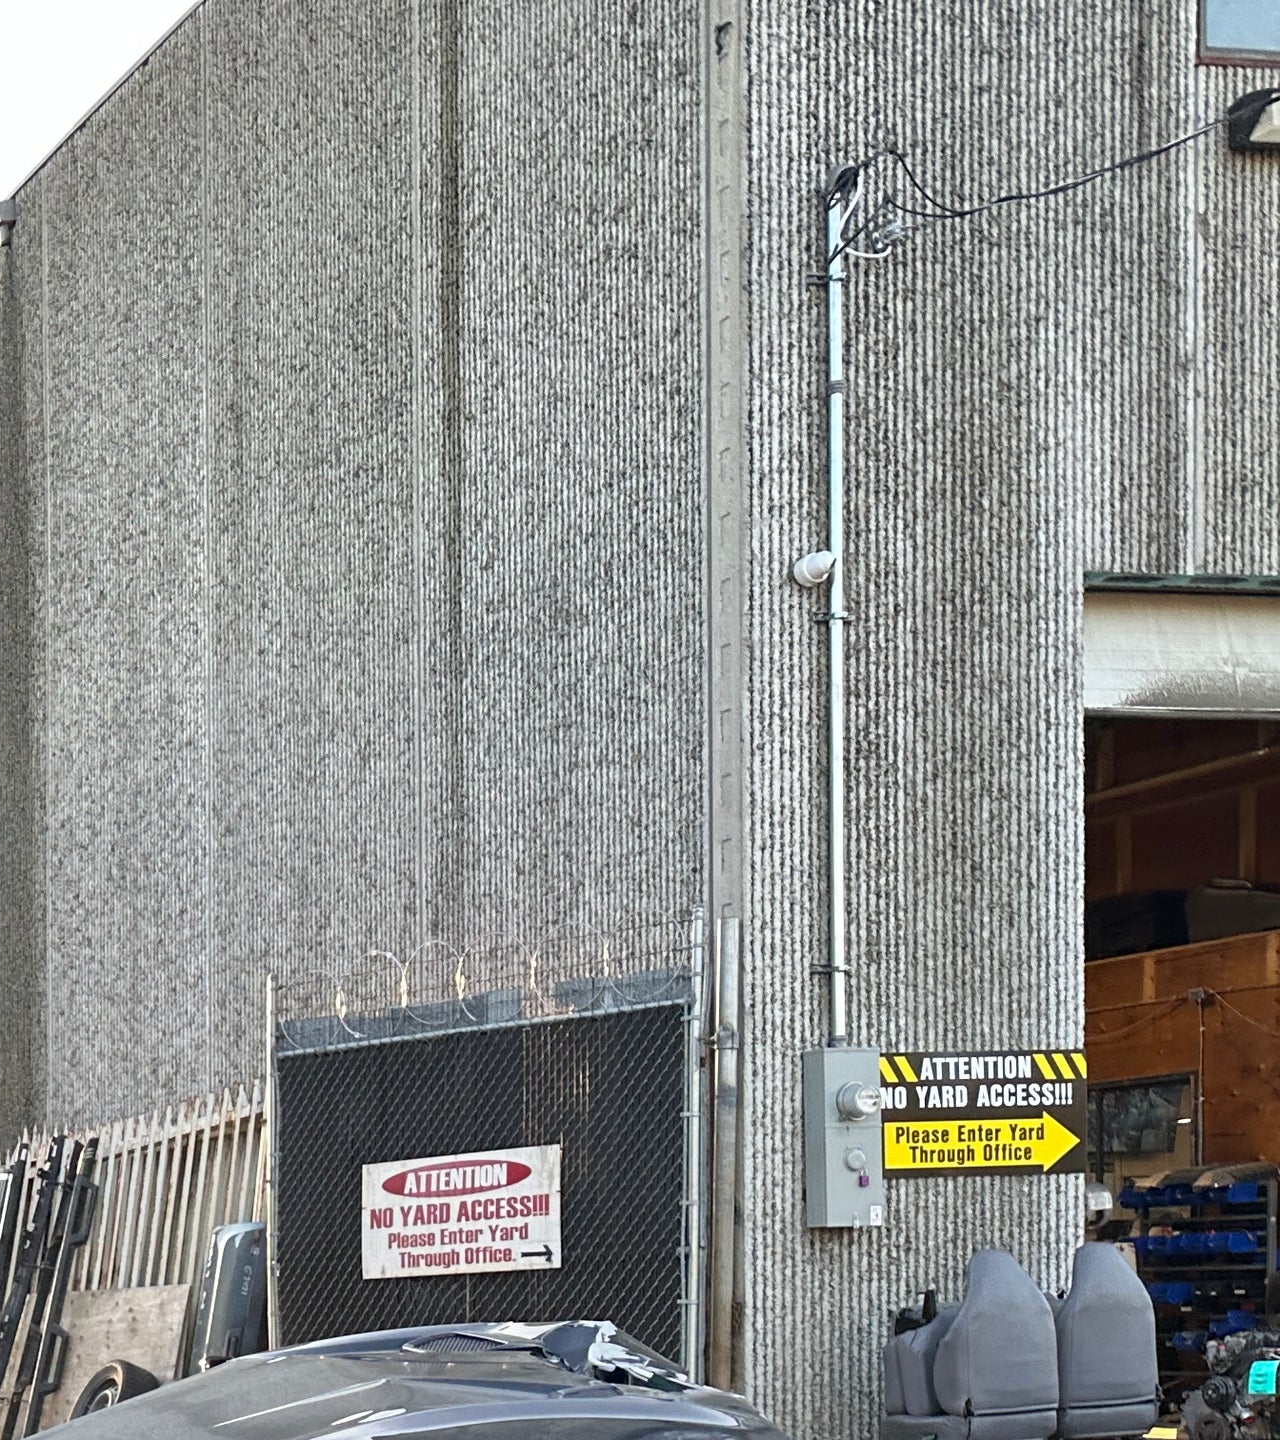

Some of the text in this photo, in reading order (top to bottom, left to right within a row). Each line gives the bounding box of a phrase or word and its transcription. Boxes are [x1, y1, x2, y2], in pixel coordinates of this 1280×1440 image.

[920, 1055, 1032, 1081] ATTENTION
[879, 1083, 1073, 1110] NO YARD ACCESS!!!
[895, 1123, 1044, 1144] Please Enter Yard
[909, 1143, 1032, 1165] Through Office
[403, 1163, 508, 1195] ATTENTION
[370, 1194, 550, 1229] NO YARD ACCESS!!!
[388, 1223, 529, 1249] Please Enter Yard
[399, 1250, 460, 1269] Through
